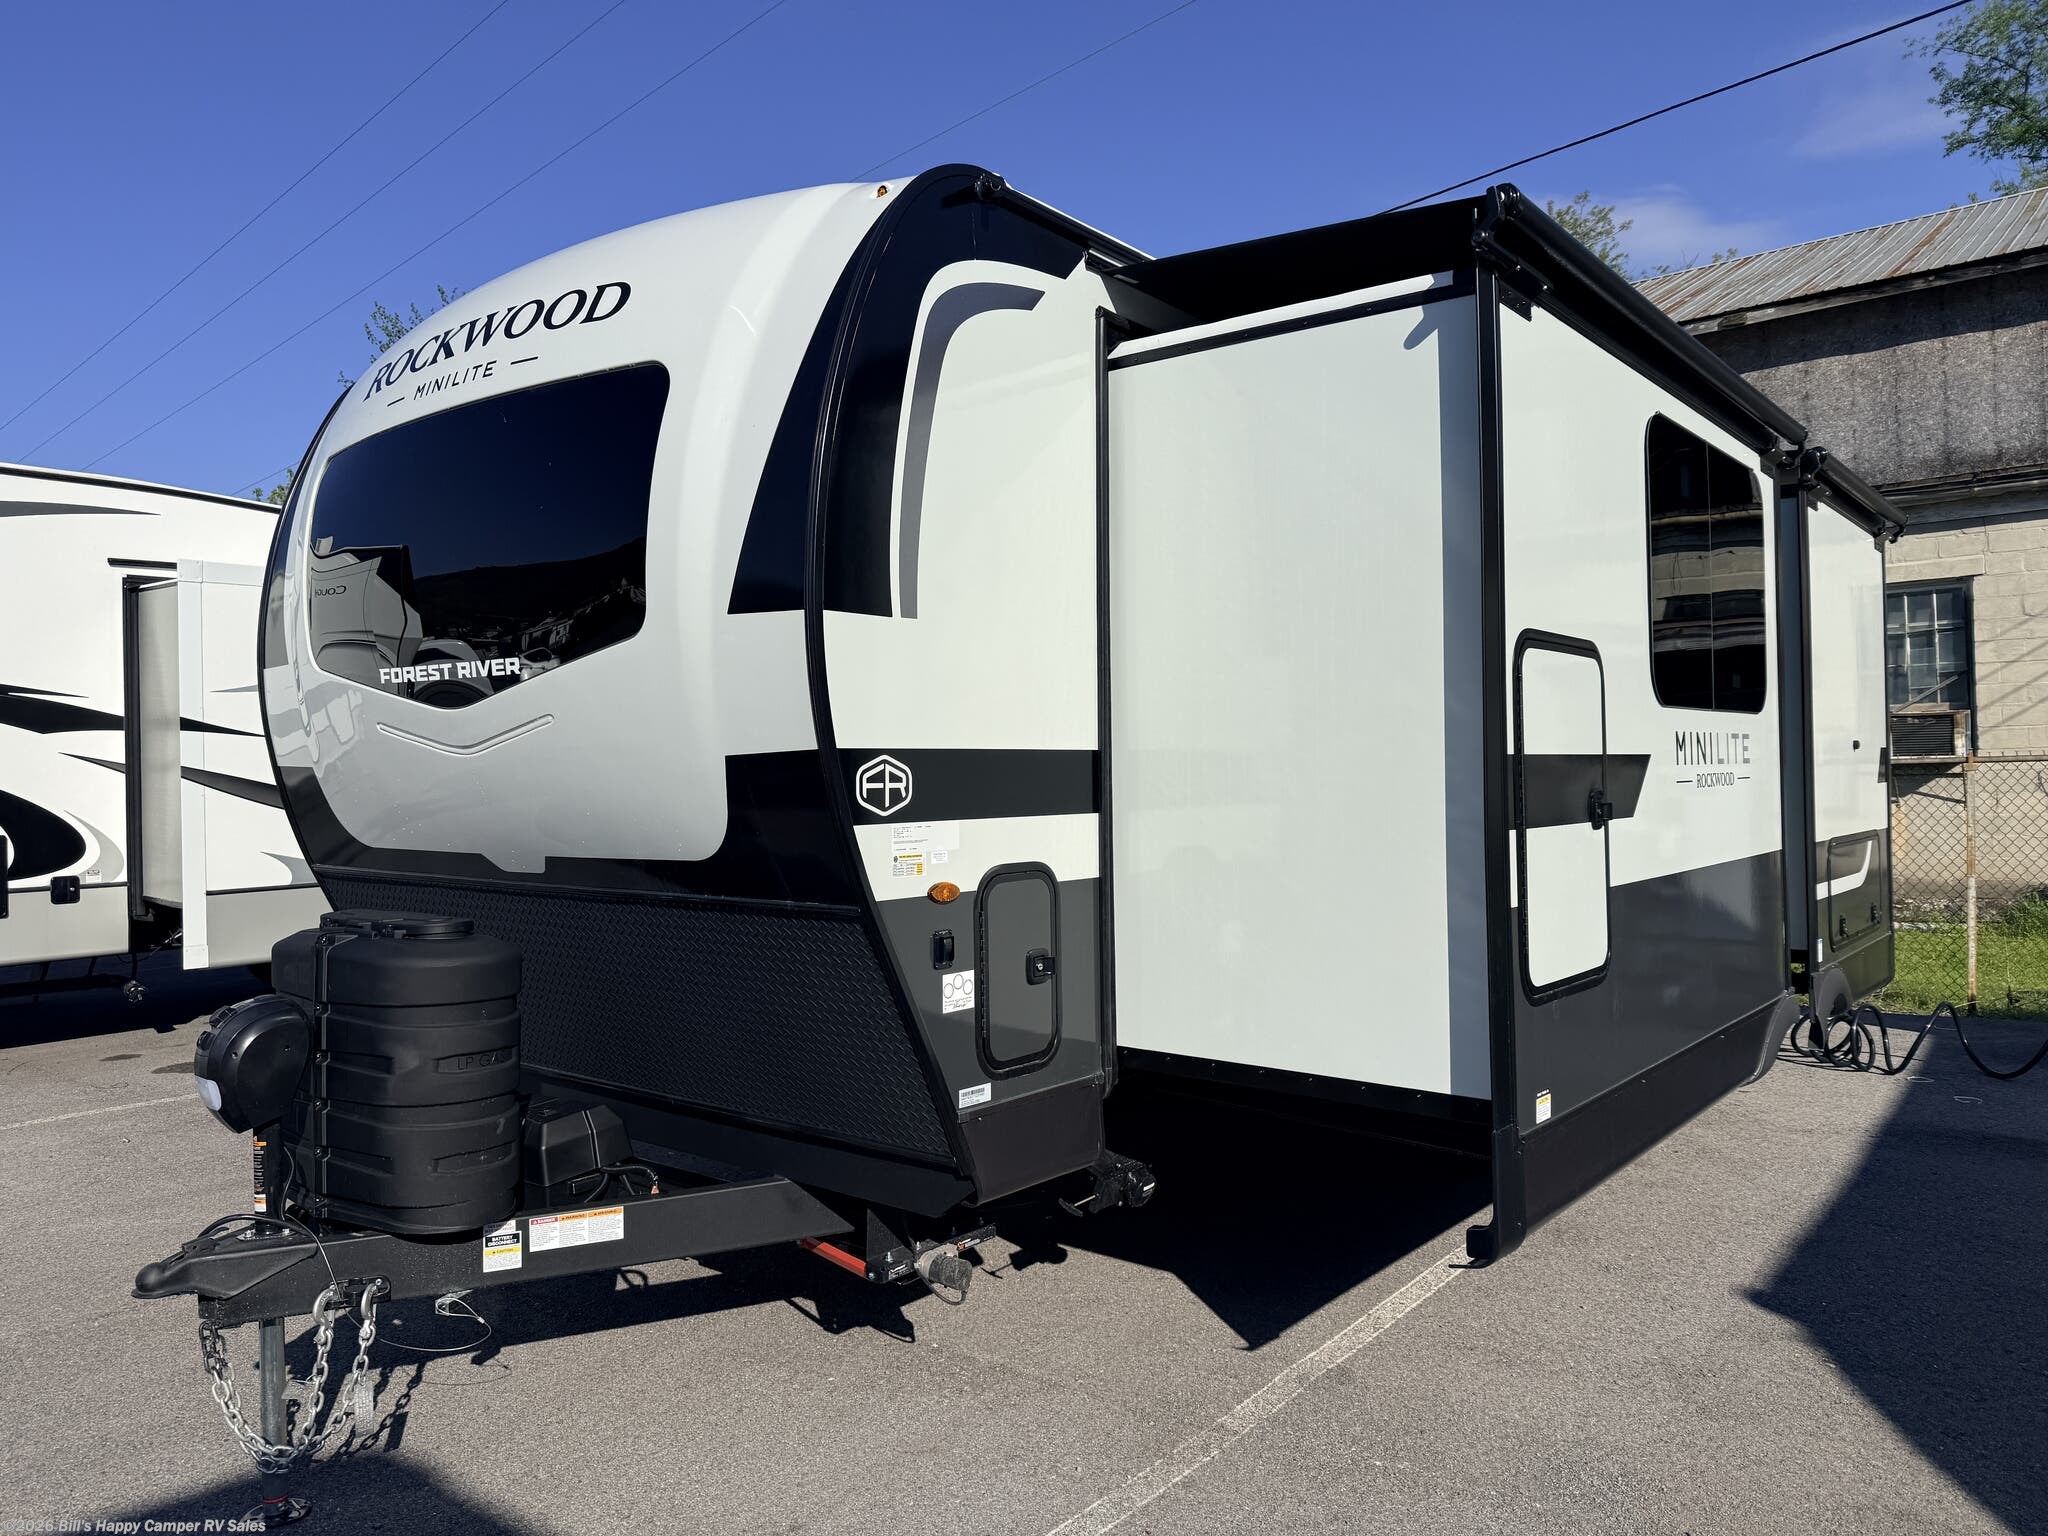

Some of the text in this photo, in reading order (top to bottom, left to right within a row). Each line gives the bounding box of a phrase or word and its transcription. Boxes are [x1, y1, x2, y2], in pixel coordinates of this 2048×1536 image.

[363, 281, 632, 403] ROCKWOOD
[413, 360, 498, 401] MINILITE
[379, 657, 521, 684] FOREST RIVER
[1675, 730, 1751, 766] MINILITE
[1696, 771, 1735, 789] ROCKWOOD
[457, 1056, 473, 1071] LP
